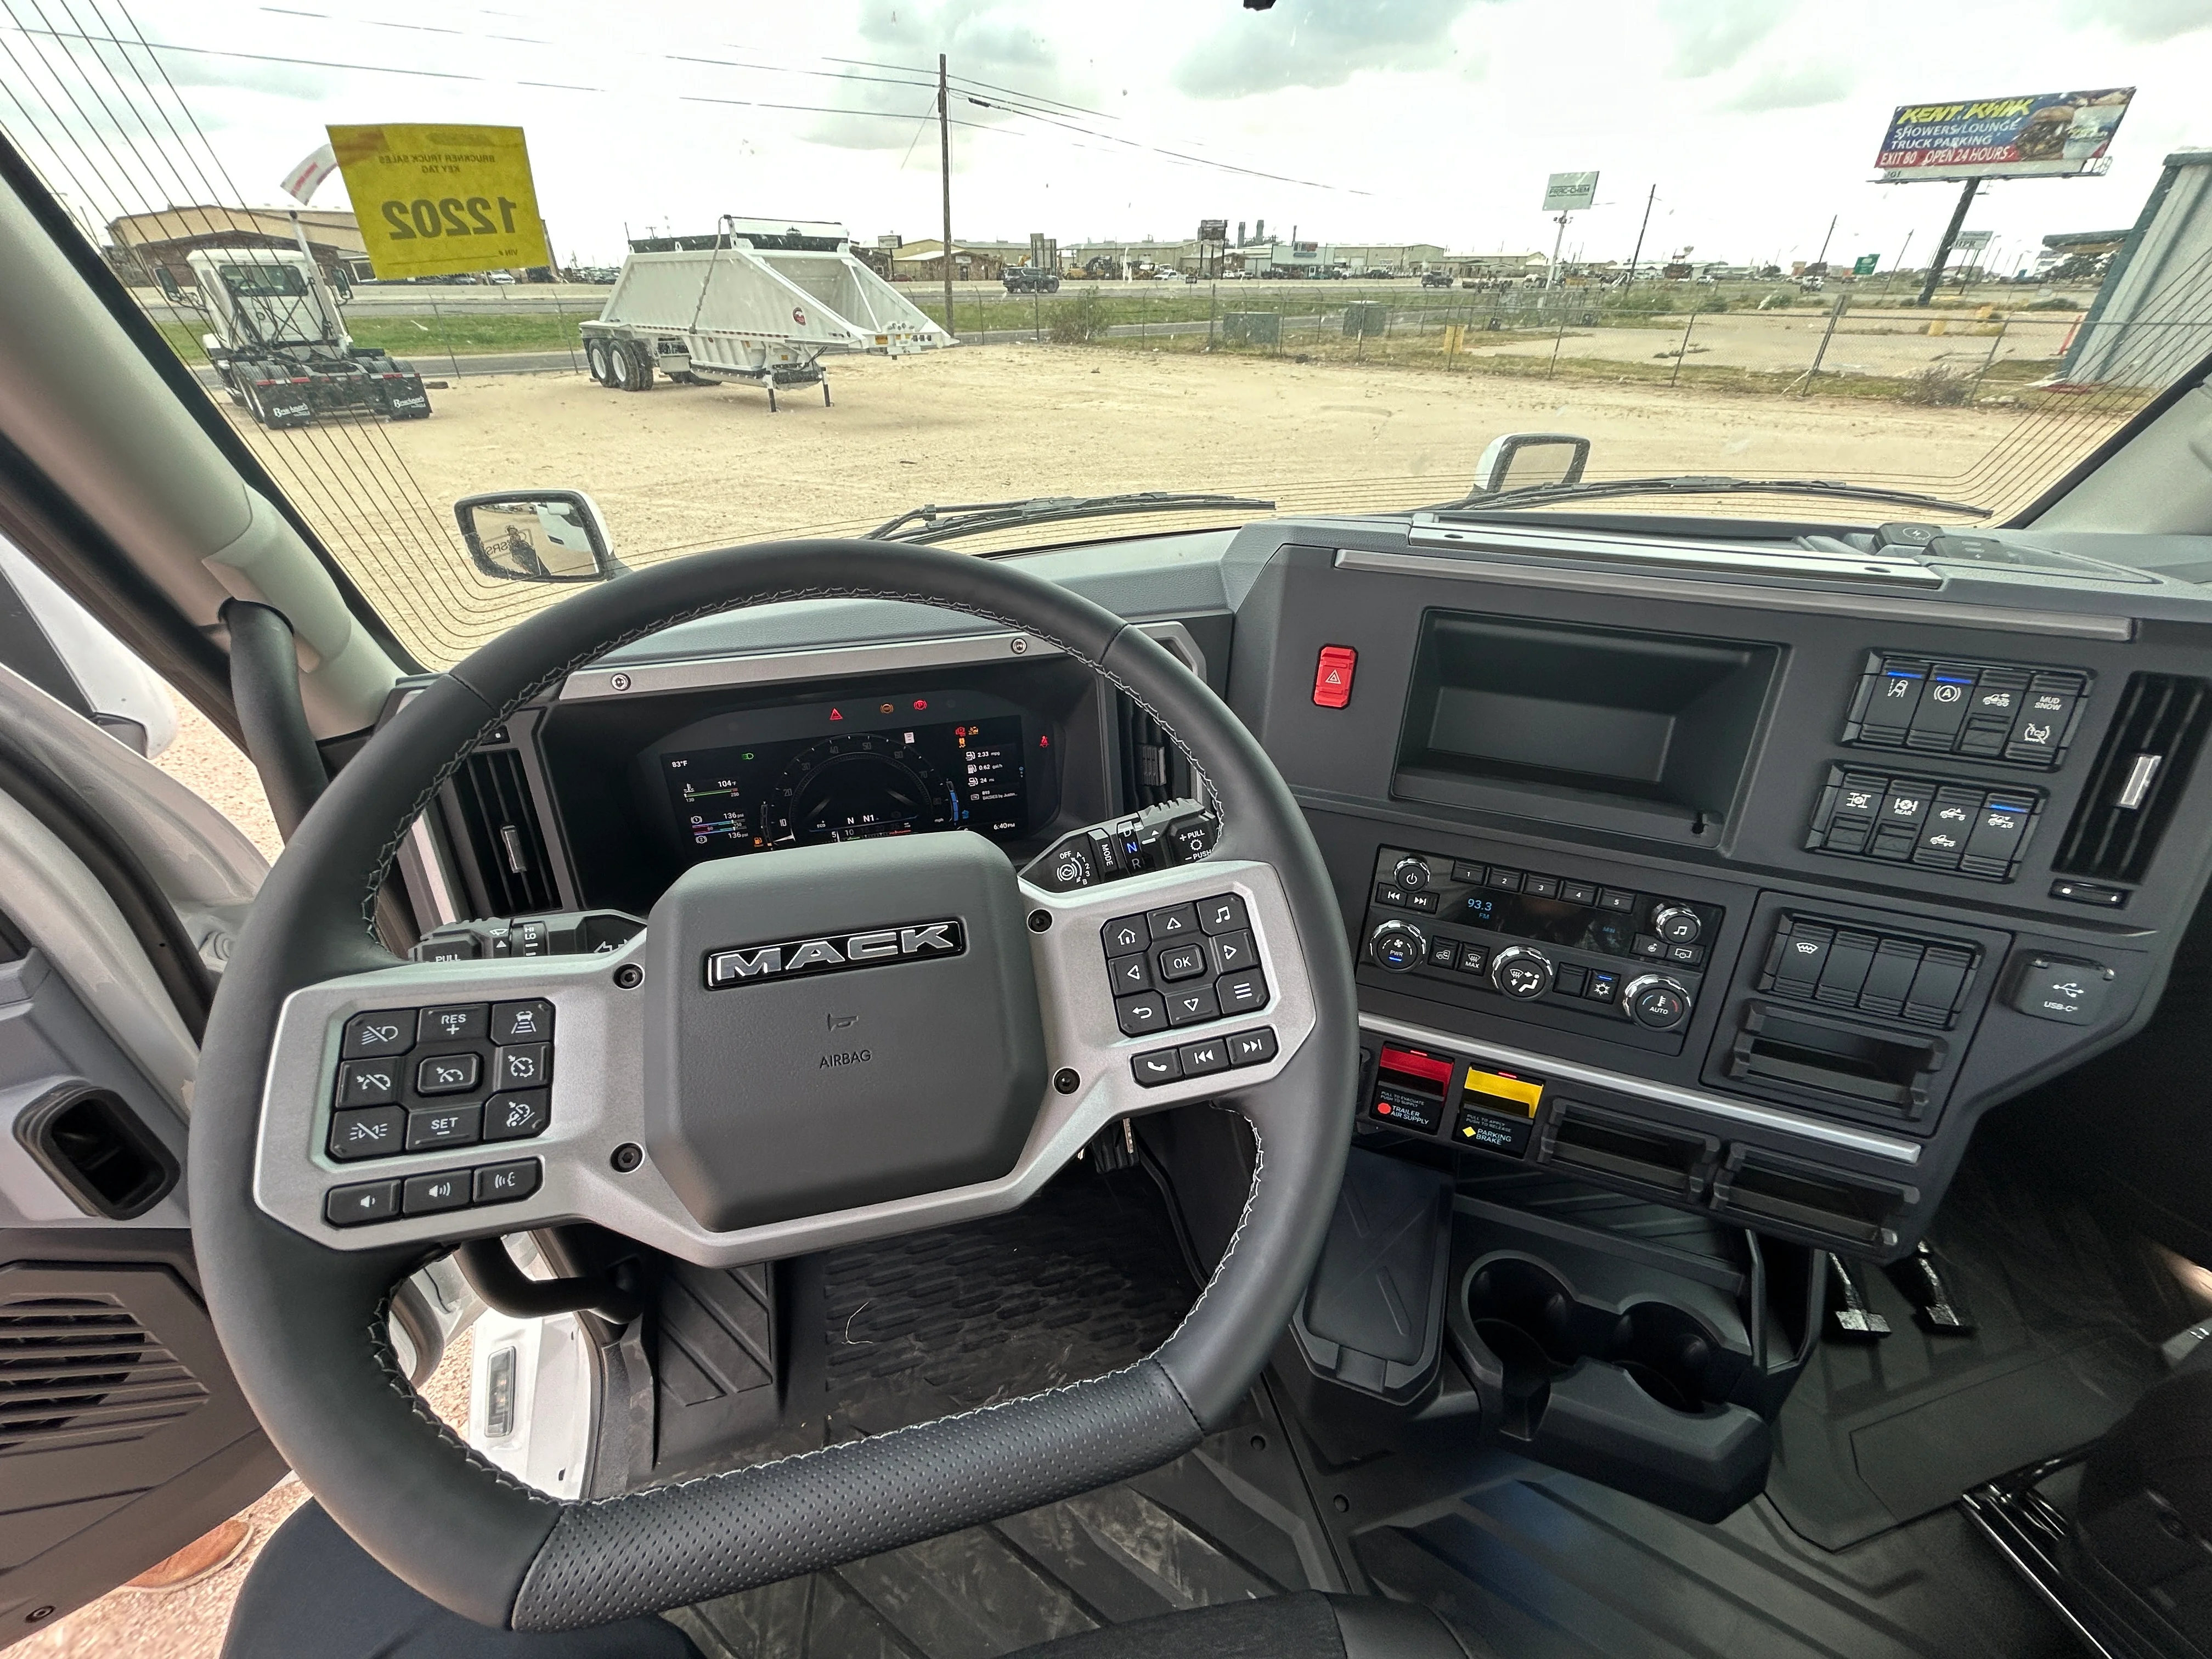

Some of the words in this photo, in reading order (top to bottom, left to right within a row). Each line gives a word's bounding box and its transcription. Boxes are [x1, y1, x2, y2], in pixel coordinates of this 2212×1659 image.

[1897, 105, 1965, 125] KENT
[1962, 98, 2034, 120] KWIK
[1894, 121, 2021, 138] SHOWERS/LOUNGE
[1891, 138, 1932, 150] TRUCK
[1933, 135, 1993, 148] PARKING
[1880, 152, 1904, 165] EXIT
[1904, 151, 1917, 164] 80
[1924, 150, 1953, 165] OPEN
[1954, 149, 1968, 162] 24
[1969, 146, 2011, 161] HOURS
[2034, 702, 2062, 710] SNOW
[2040, 696, 2061, 704] MUD
[780, 819, 787, 827] 10
[1187, 829, 1205, 839] PULL
[1126, 842, 1138, 854] N
[1059, 851, 1071, 860] OFF
[1102, 844, 1113, 866] MODE
[1132, 858, 1141, 870] R
[1467, 898, 1492, 911] 93.3
[717, 925, 953, 981] MACK
[1173, 956, 1192, 968] OK
[1650, 1006, 1668, 1015] AUTO
[441, 1014, 466, 1025] RES
[820, 1049, 872, 1069] AIRBAG
[1401, 1096, 1425, 1105] EVACUATE
[1392, 1105, 1420, 1117] TRAILER
[431, 1117, 458, 1128] SET
[1403, 1114, 1429, 1125] SUPPLY
[1476, 1133, 1502, 1146] BRAKE
[1477, 1128, 1511, 1142] PARKING
